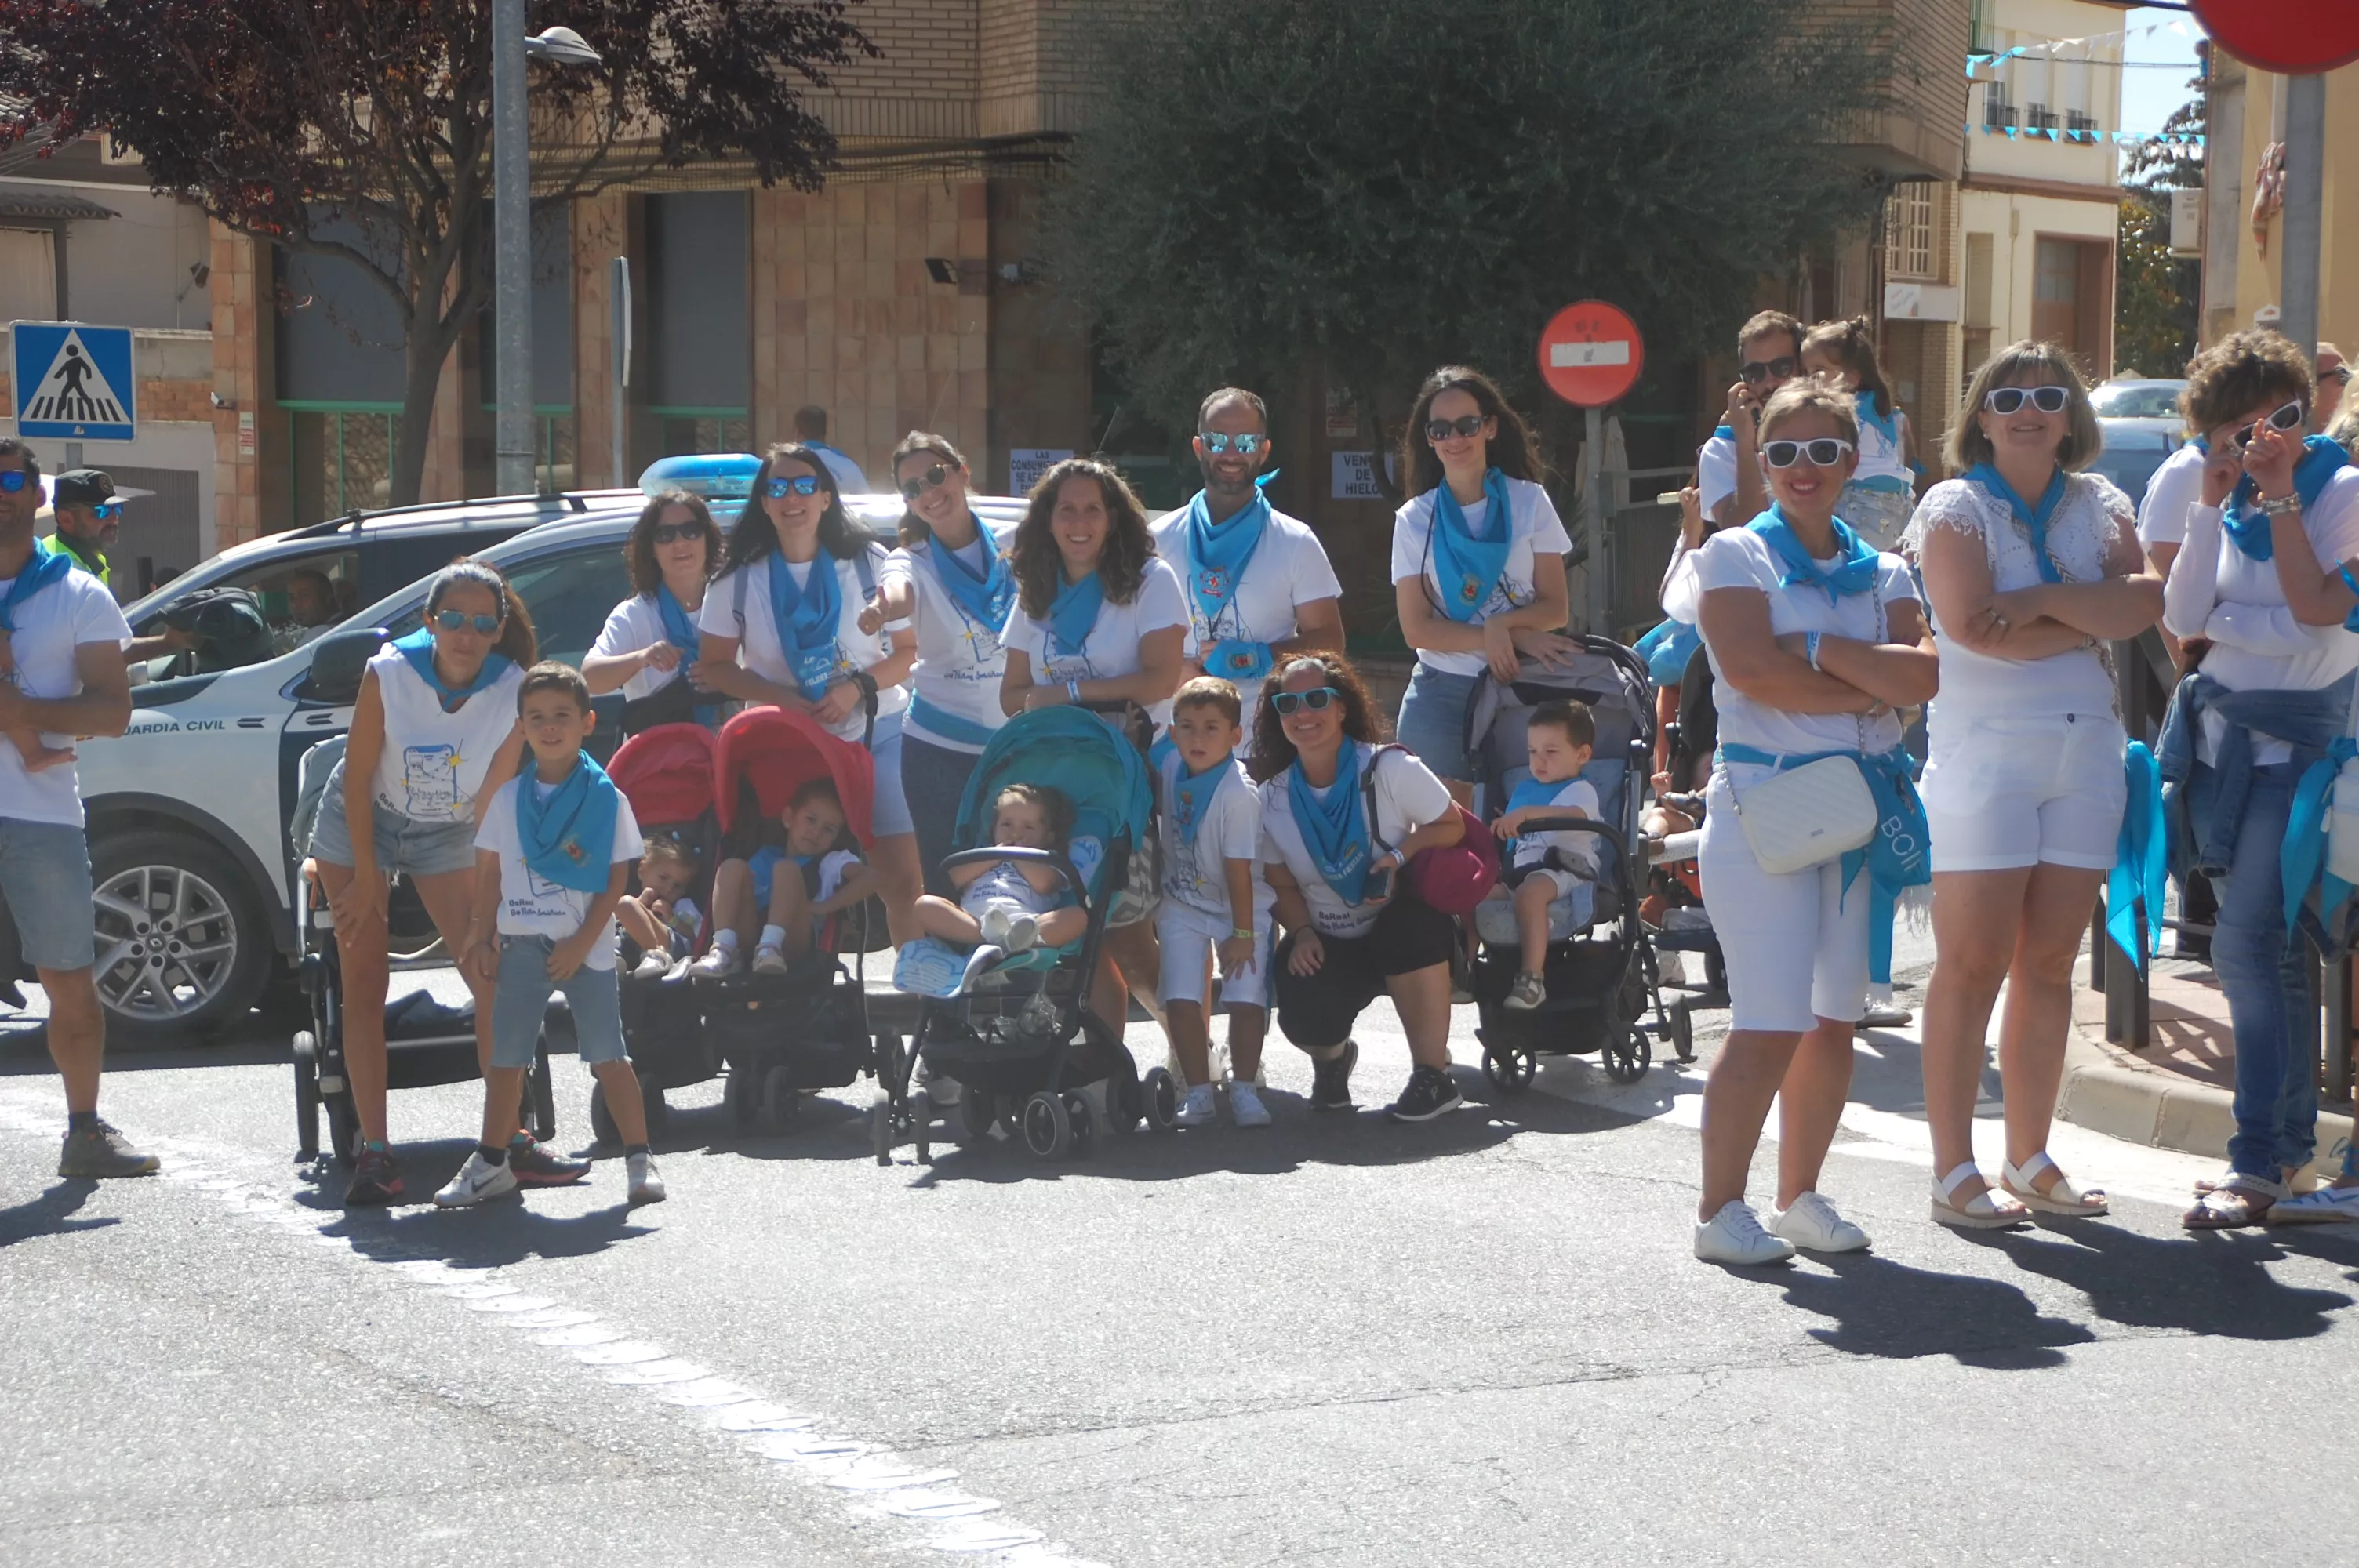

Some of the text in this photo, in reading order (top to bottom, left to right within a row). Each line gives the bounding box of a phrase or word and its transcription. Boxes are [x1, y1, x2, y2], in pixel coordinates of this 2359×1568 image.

[1343, 455, 1367, 466] VEN
[1016, 472, 1026, 482] SE
[1355, 469, 1371, 481] DE
[1345, 483, 1379, 495] HIELO
[124, 720, 226, 735] UARDIA CIVIL
